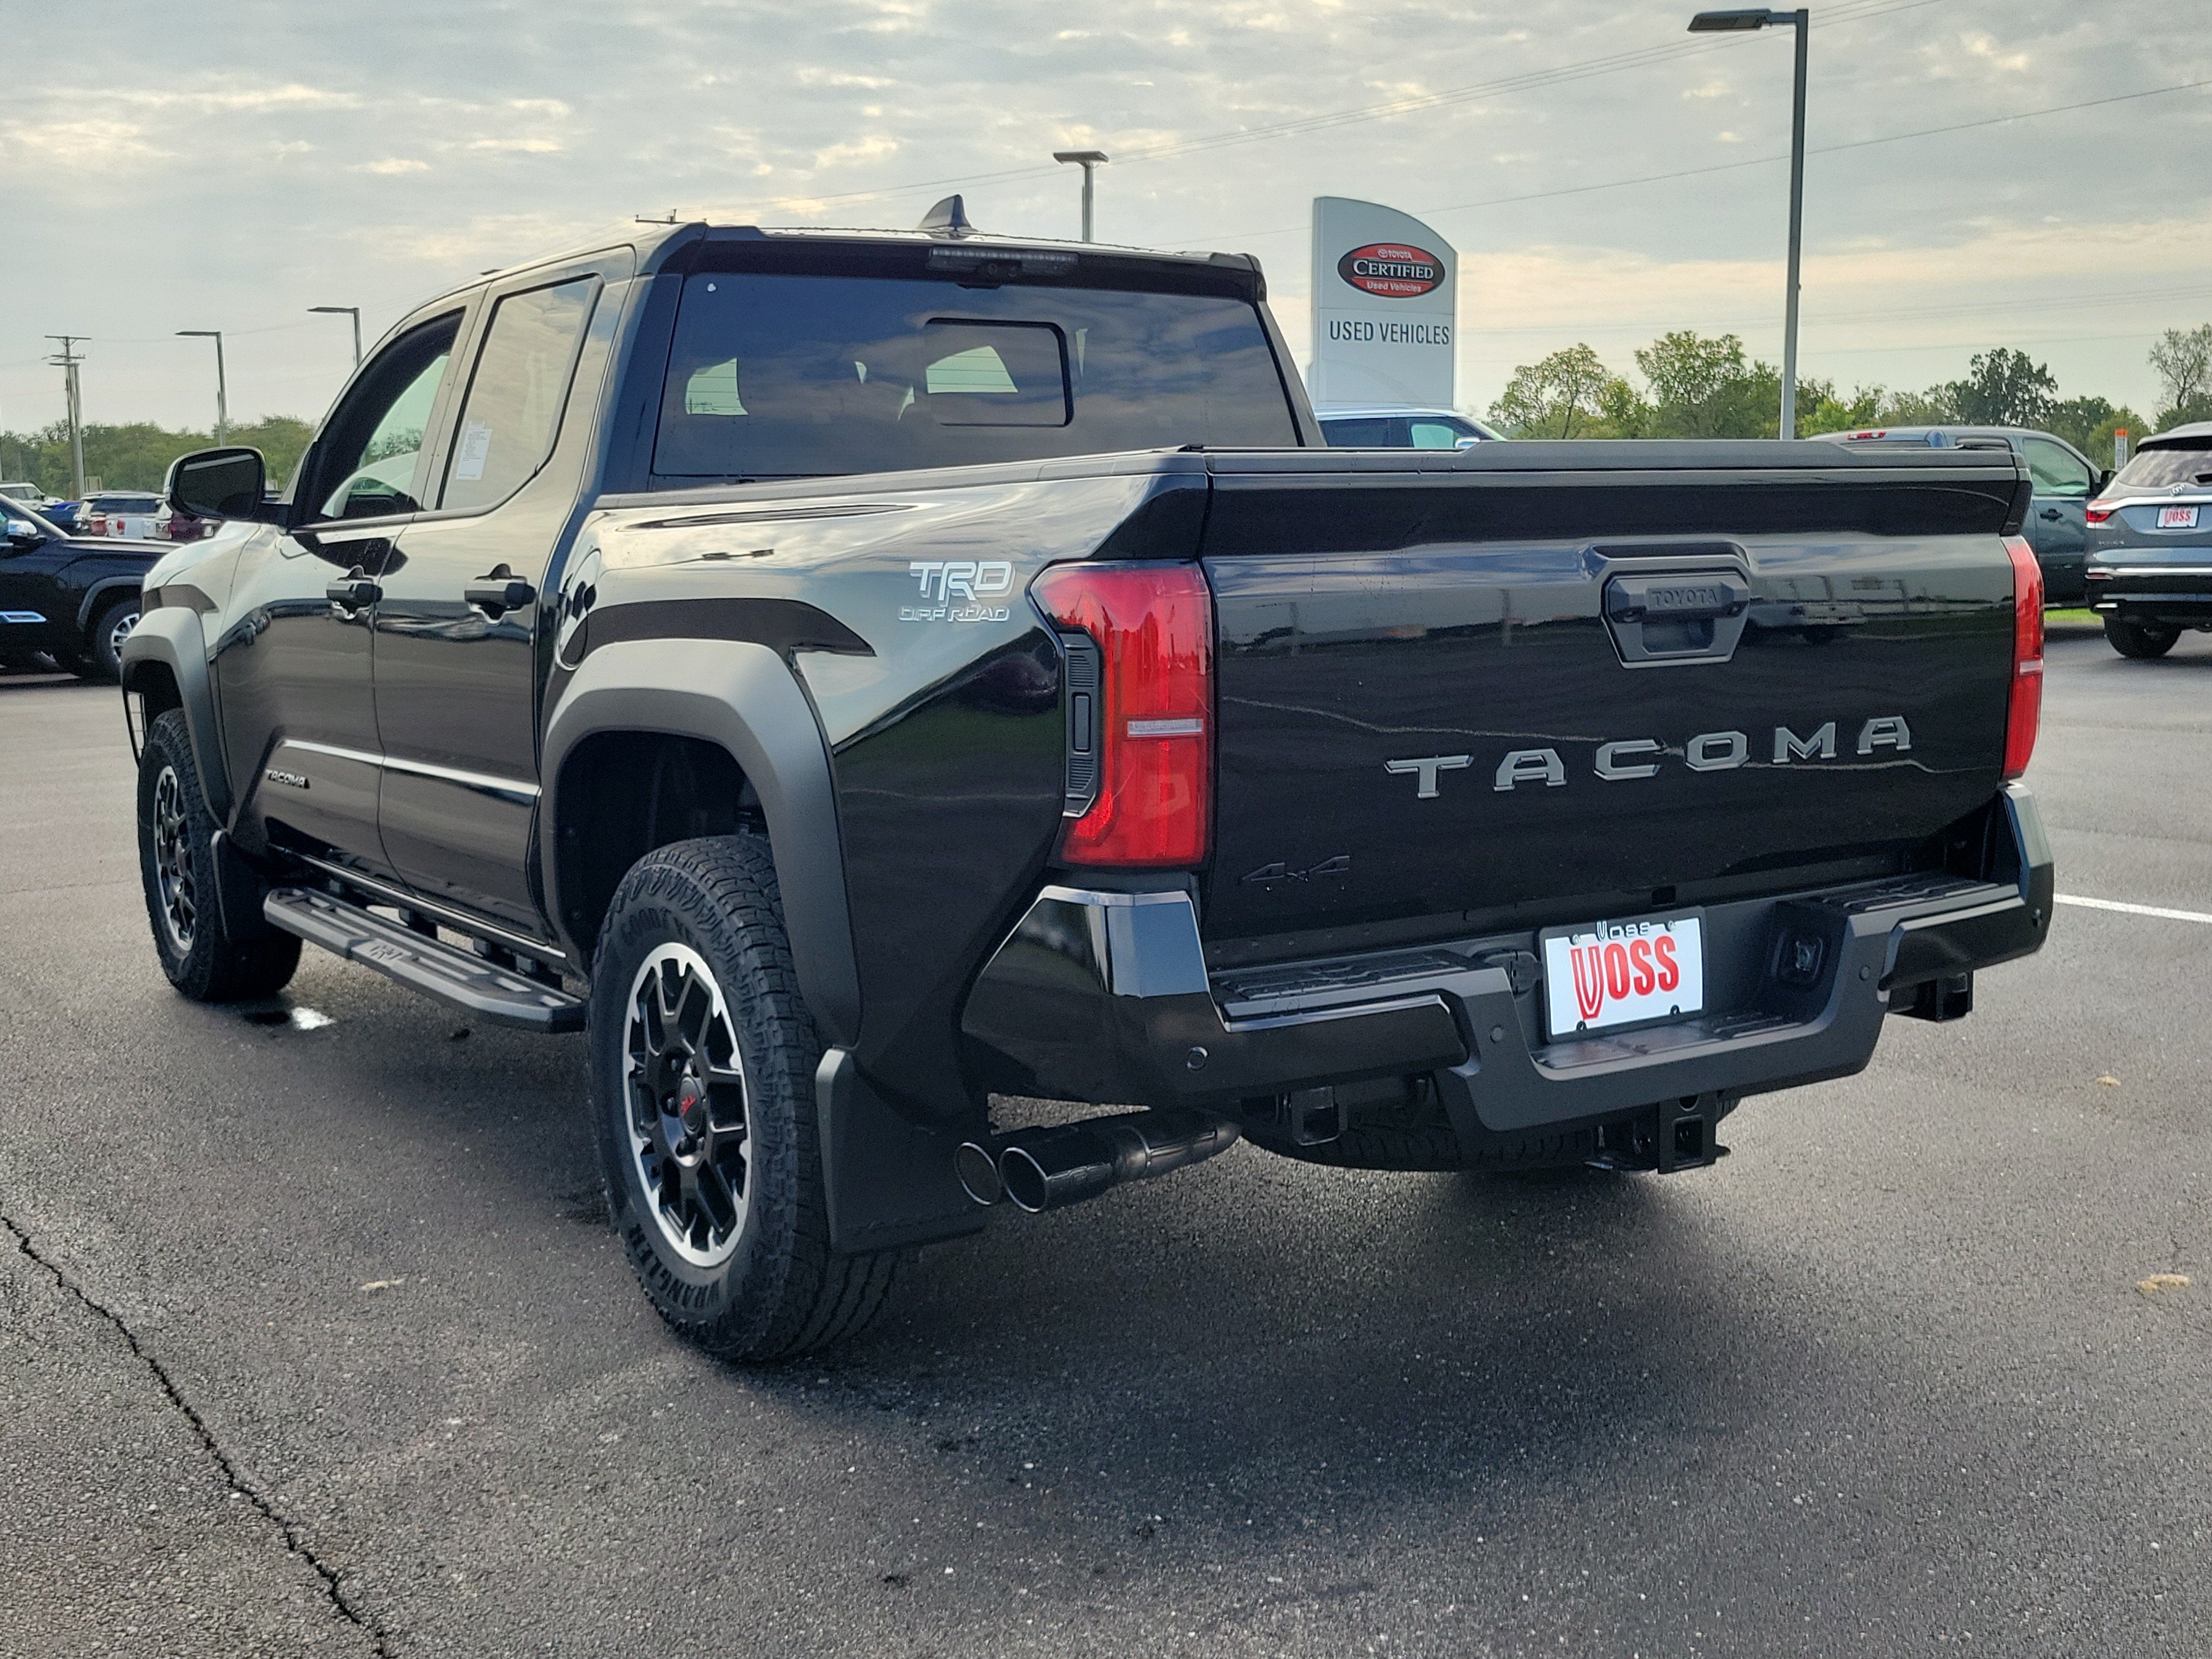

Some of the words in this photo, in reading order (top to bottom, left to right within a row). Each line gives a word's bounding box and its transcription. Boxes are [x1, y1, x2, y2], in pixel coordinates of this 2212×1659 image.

[1388, 250, 1413, 260] TOYOTA
[1352, 259, 1434, 280] CERTIFIED
[1366, 281, 1389, 291] Used
[1389, 282, 1422, 293] Vehicles
[1329, 320, 1374, 342] USED
[1379, 322, 1450, 346] VEHICLES
[909, 561, 1015, 607] TRD
[1651, 588, 1718, 608] TOYOTA
[898, 606, 946, 622] OFF
[947, 606, 1011, 623] ROAD
[1384, 715, 1912, 799] TACOMA
[266, 769, 311, 789] TACOMA
[1570, 935, 1680, 1021] VOSS
